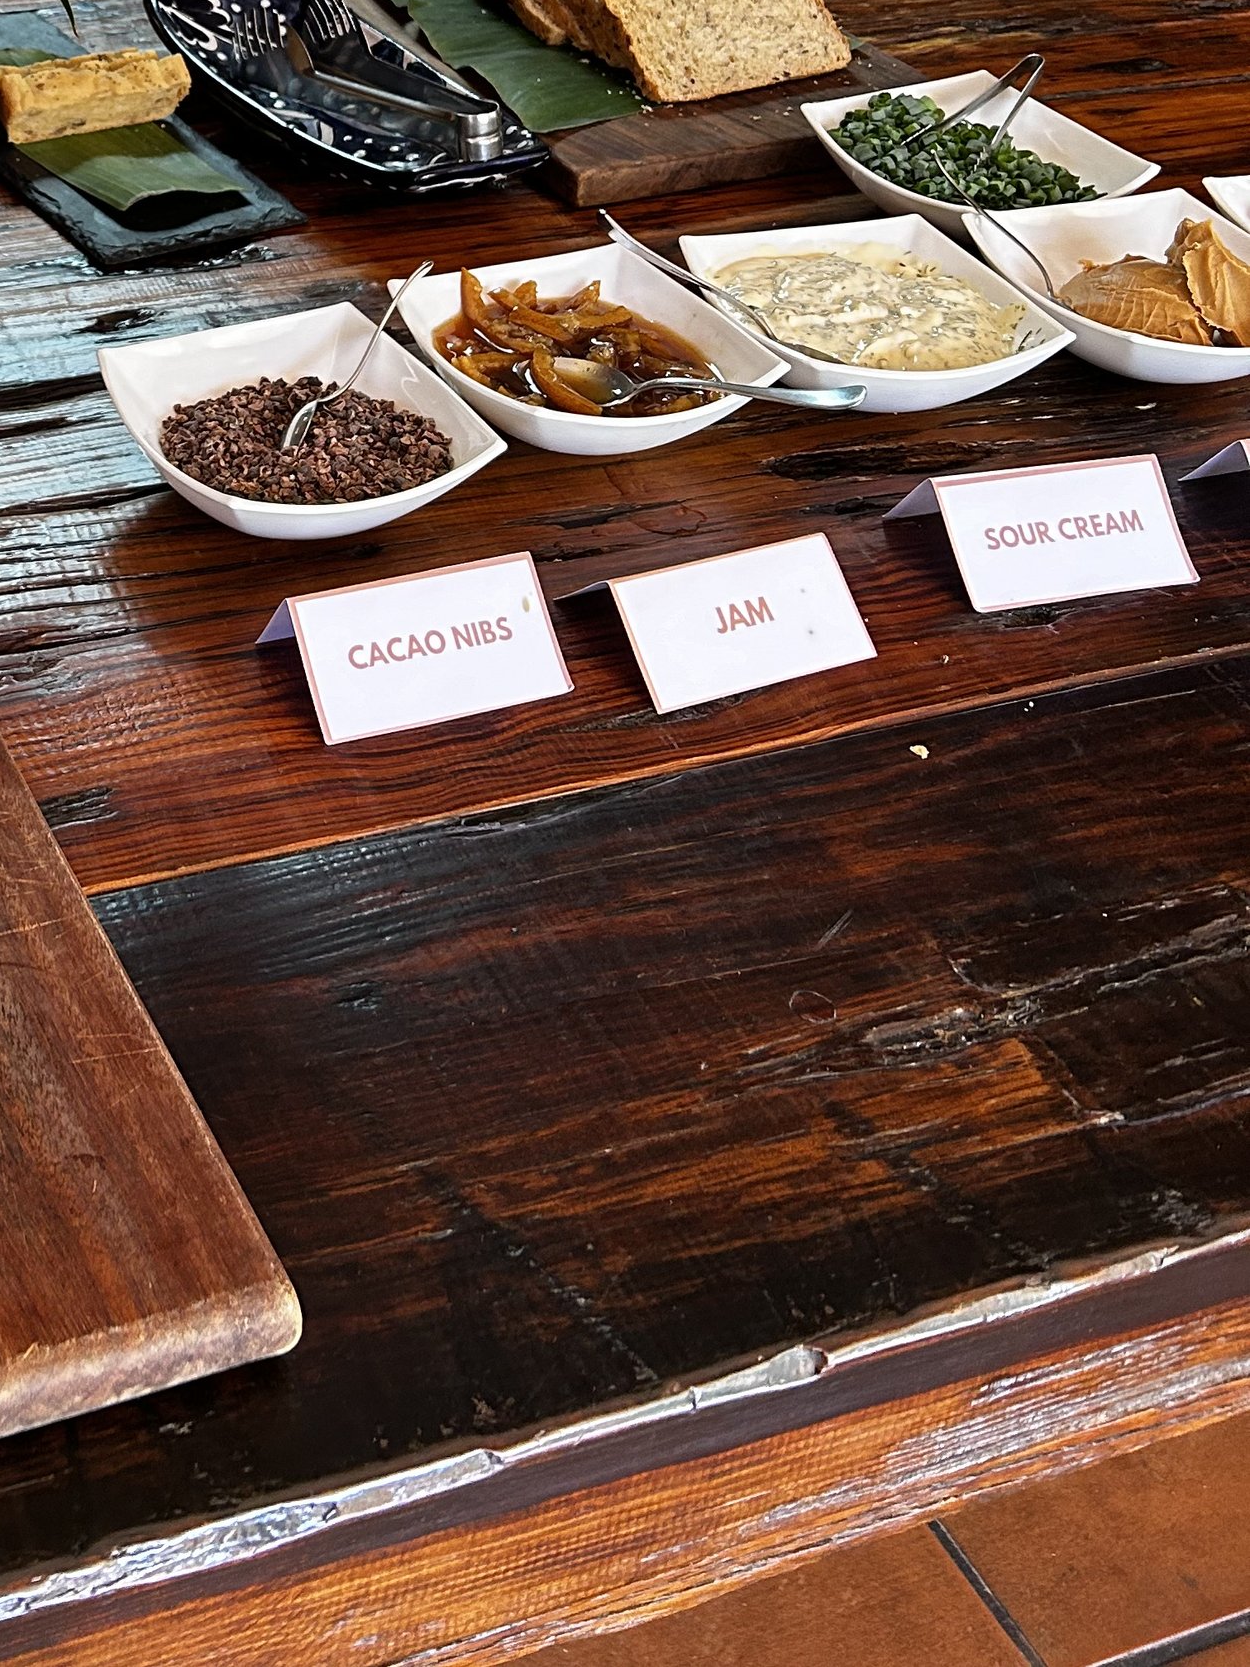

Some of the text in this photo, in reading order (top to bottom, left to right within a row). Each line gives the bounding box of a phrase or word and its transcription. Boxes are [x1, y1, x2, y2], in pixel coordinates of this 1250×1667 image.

[984, 509, 1145, 550] SOUR CREAM
[714, 595, 776, 634] JAM
[347, 616, 514, 670] CACAO NIBS
